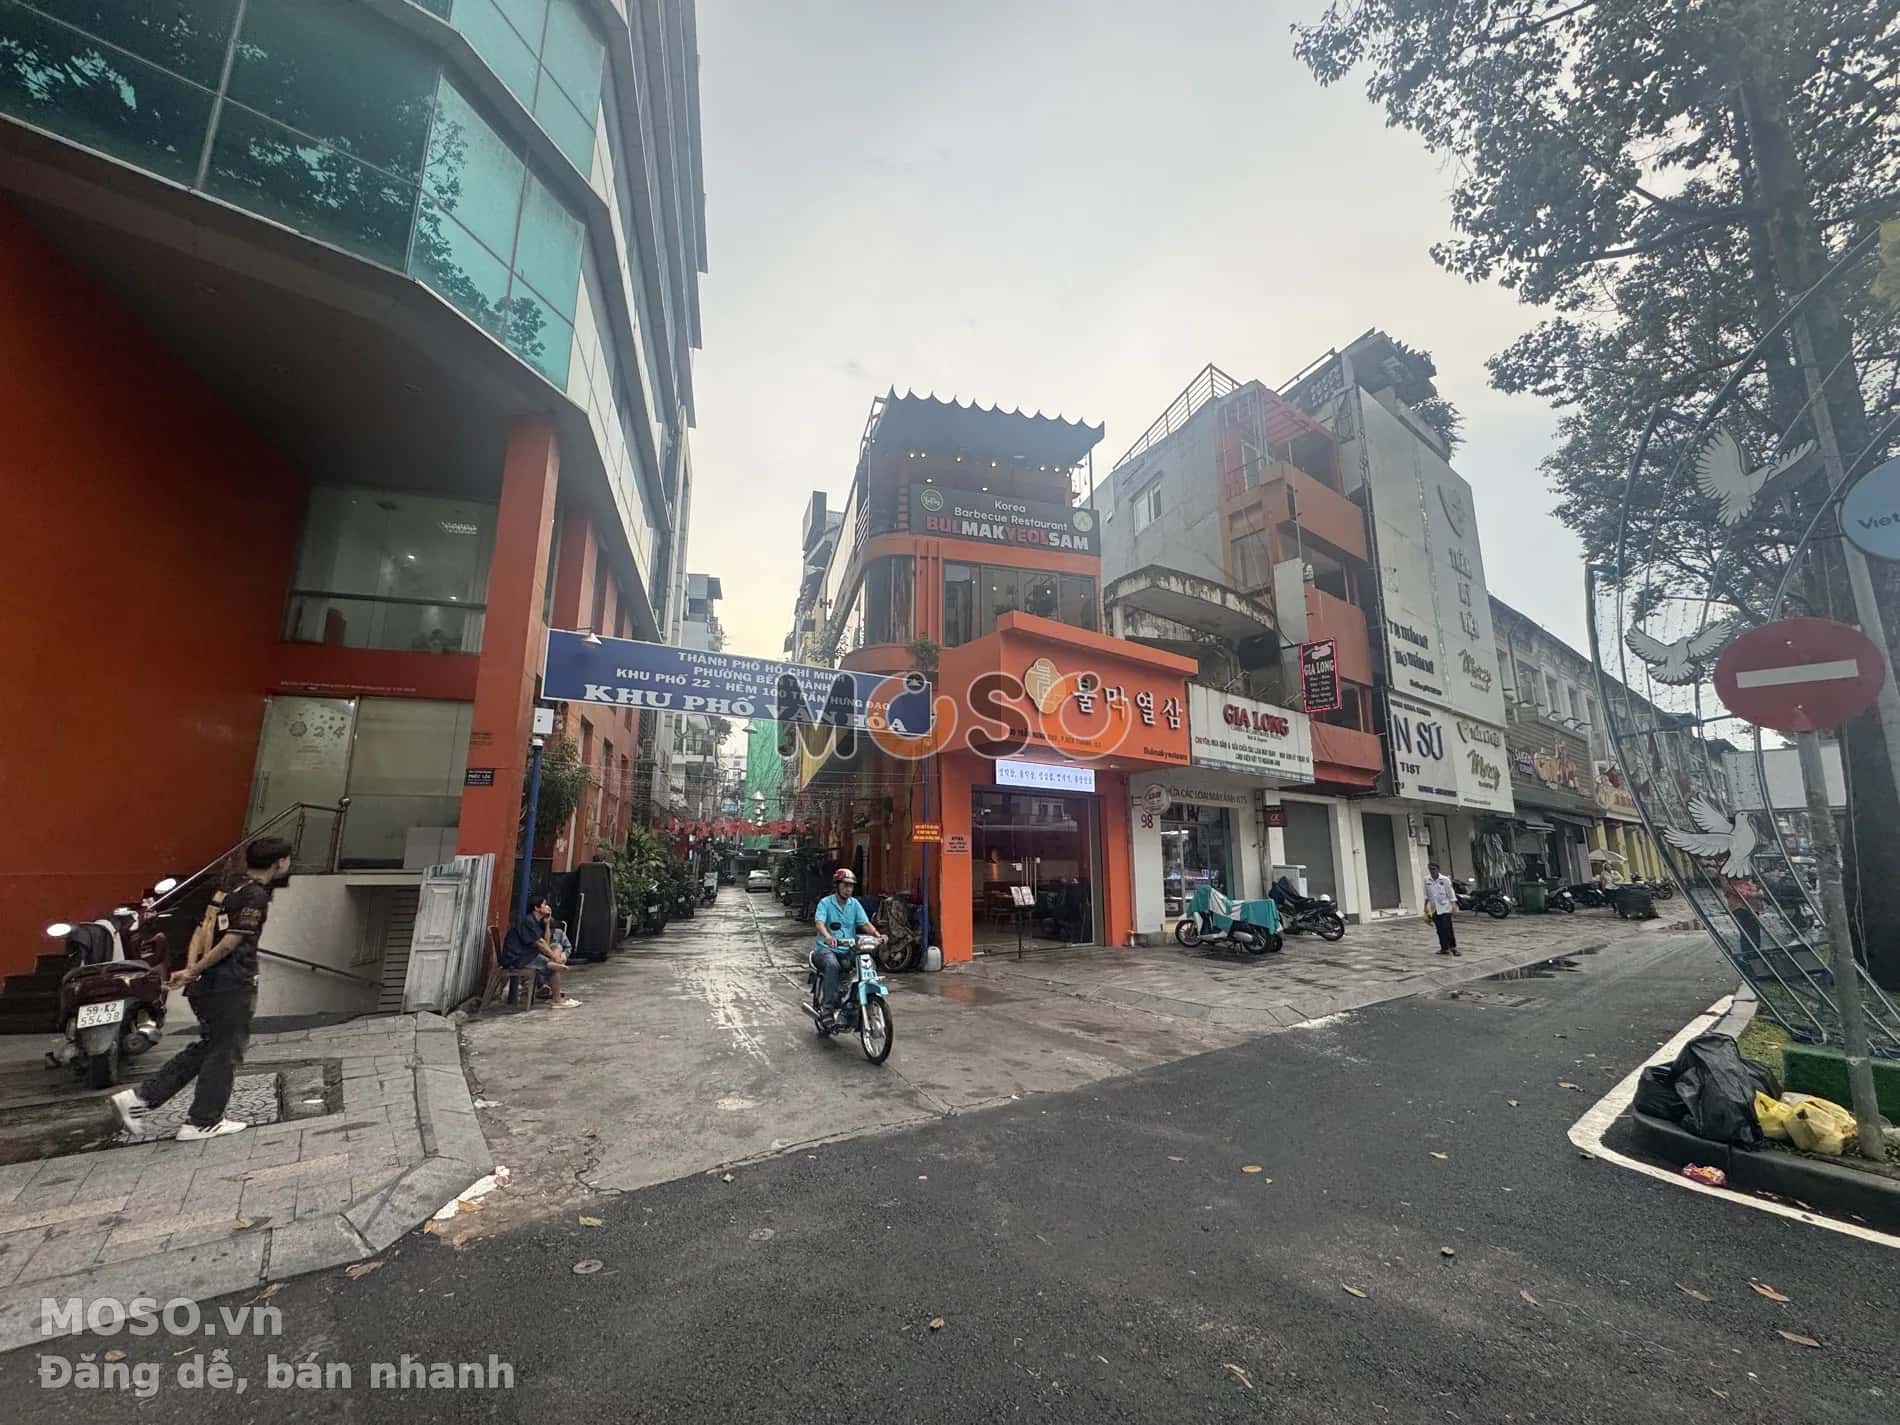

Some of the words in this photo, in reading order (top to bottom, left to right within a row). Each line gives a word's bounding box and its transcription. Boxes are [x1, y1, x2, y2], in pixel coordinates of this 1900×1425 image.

[994, 499, 1026, 513] Korea
[954, 506, 1008, 524] Barbecue
[1011, 513, 1068, 532] Restaurant
[616, 667, 651, 681] KHU
[655, 672, 689, 686] PHỐ
[692, 678, 712, 689] 22
[693, 665, 752, 682] PHƯỜNG
[732, 658, 761, 671] PHỐ
[788, 665, 810, 678] CHÍ
[813, 670, 846, 682] MINH
[1316, 660, 1335, 674] LONG
[584, 683, 673, 708] KHU
[683, 695, 755, 716] PHỐ
[765, 702, 836, 725] VĂN
[1223, 703, 1250, 729] GIA
[1251, 711, 1290, 737] LONG
[1141, 814, 1154, 829] 98
